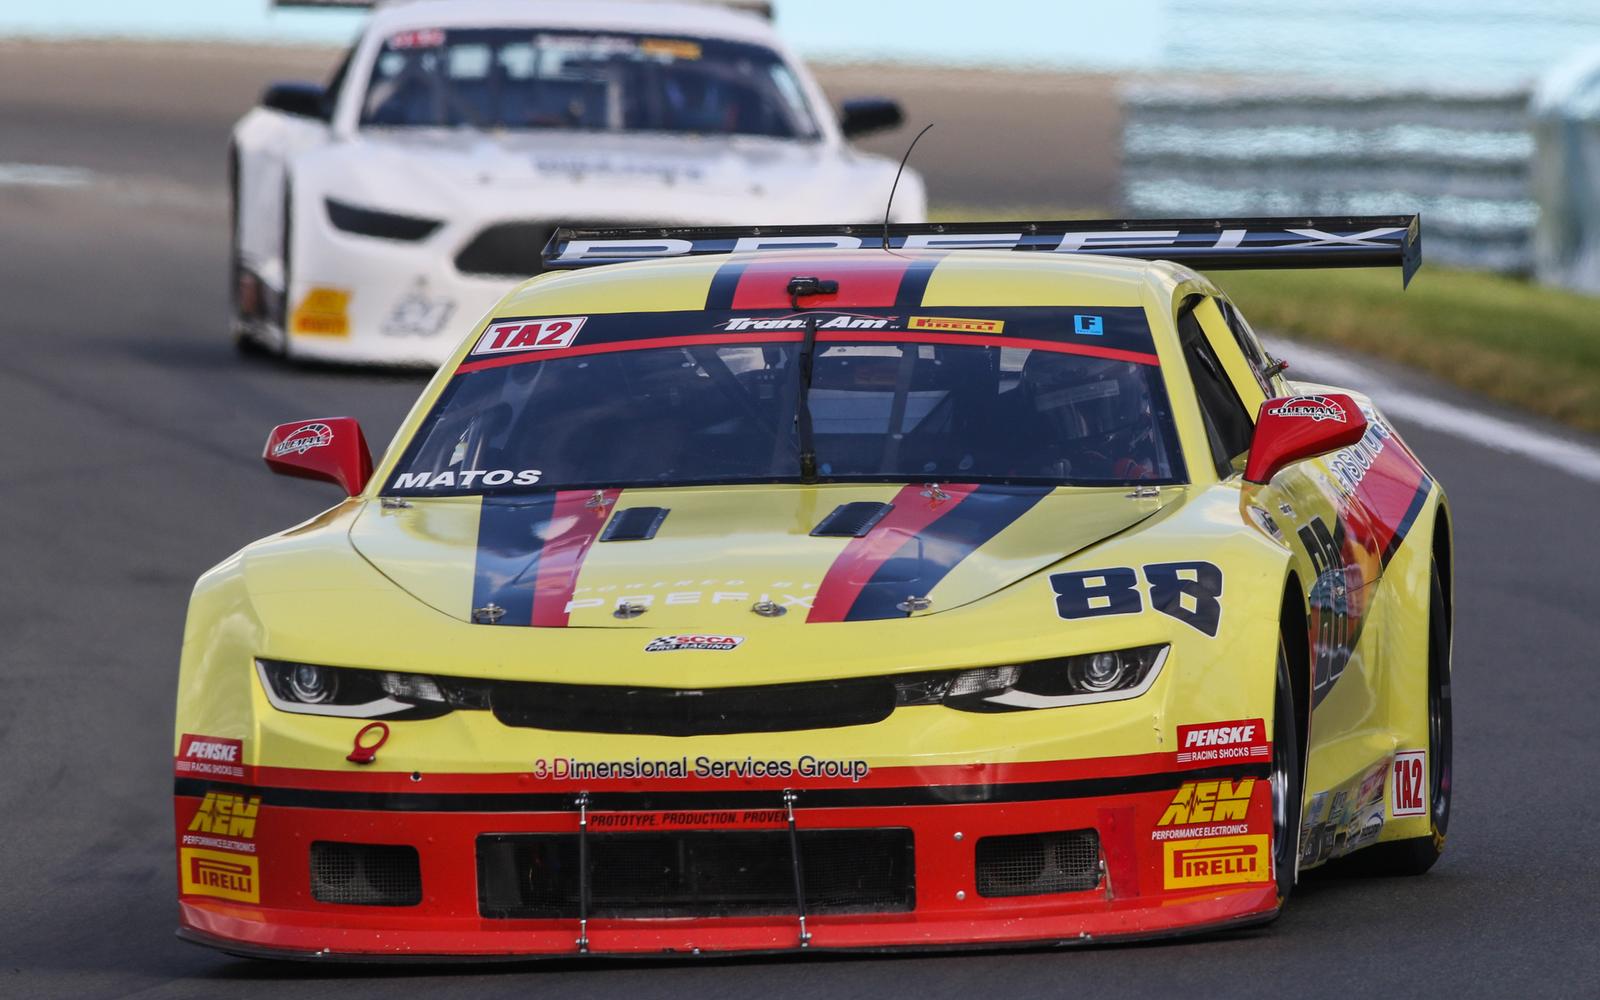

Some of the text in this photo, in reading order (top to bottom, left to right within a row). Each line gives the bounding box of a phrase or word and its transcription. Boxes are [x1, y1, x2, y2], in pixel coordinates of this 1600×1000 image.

[820, 317, 889, 329] Am
[916, 319, 996, 331] PIRELLI
[1081, 317, 1096, 330] F
[490, 322, 573, 349] TA2
[1268, 407, 1335, 415] COLEMAN
[393, 470, 542, 489] MATOS
[563, 592, 815, 613] PREFIX
[1049, 561, 1223, 639] 88
[647, 644, 676, 652] PRO
[677, 636, 735, 645] SCCA
[1185, 725, 1256, 748] PENSKE
[186, 741, 238, 762] PENSKE
[1191, 747, 1249, 761] RACING SHOCKS
[534, 755, 869, 782] 3-Dimensional Services Group
[1394, 758, 1423, 810] TA2
[1157, 778, 1257, 827] AEM
[187, 792, 260, 838] AEM
[591, 814, 659, 827] PROTOTYPE.
[662, 812, 738, 825] PRODUCTION.
[1151, 823, 1249, 841] PERFORMANCE ELECTRONICS
[1173, 844, 1259, 878] PIRELLI
[191, 857, 253, 893] PIRELLI
